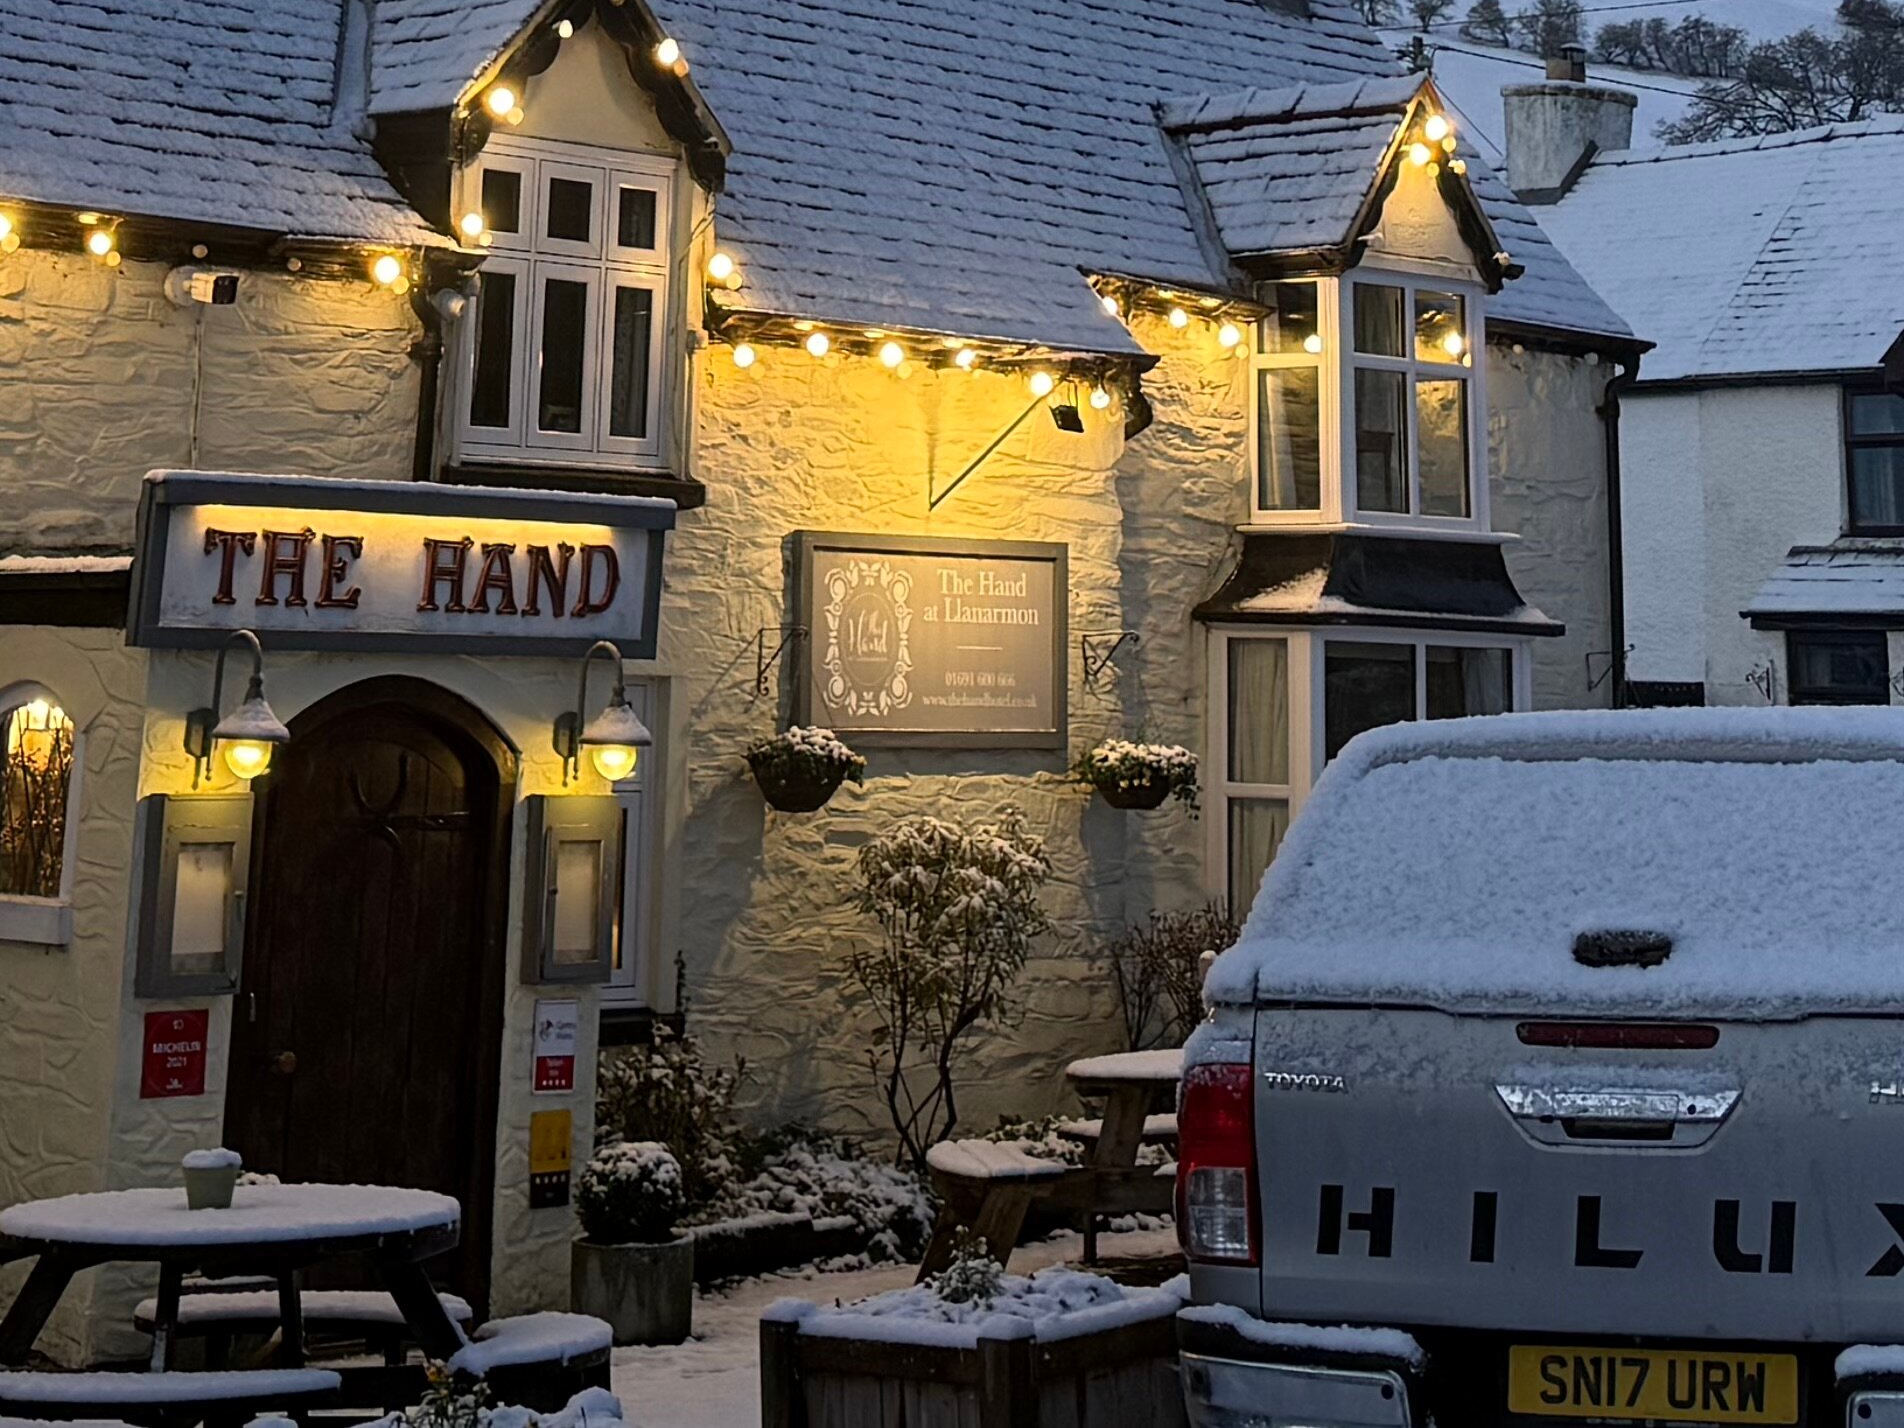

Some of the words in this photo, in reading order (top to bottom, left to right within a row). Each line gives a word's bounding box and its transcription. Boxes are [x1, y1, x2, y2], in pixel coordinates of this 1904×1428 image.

[204, 526, 365, 609] THE
[416, 535, 621, 619] HAND
[937, 568, 974, 596] The
[978, 570, 1027, 598] Hand
[923, 604, 940, 623] at
[943, 596, 1039, 626] Llanarmon
[944, 671, 975, 687] 01691
[1263, 1071, 1350, 1095] TOYOTA
[1539, 1354, 1651, 1409] SN17
[1666, 1358, 1766, 1414] URW
